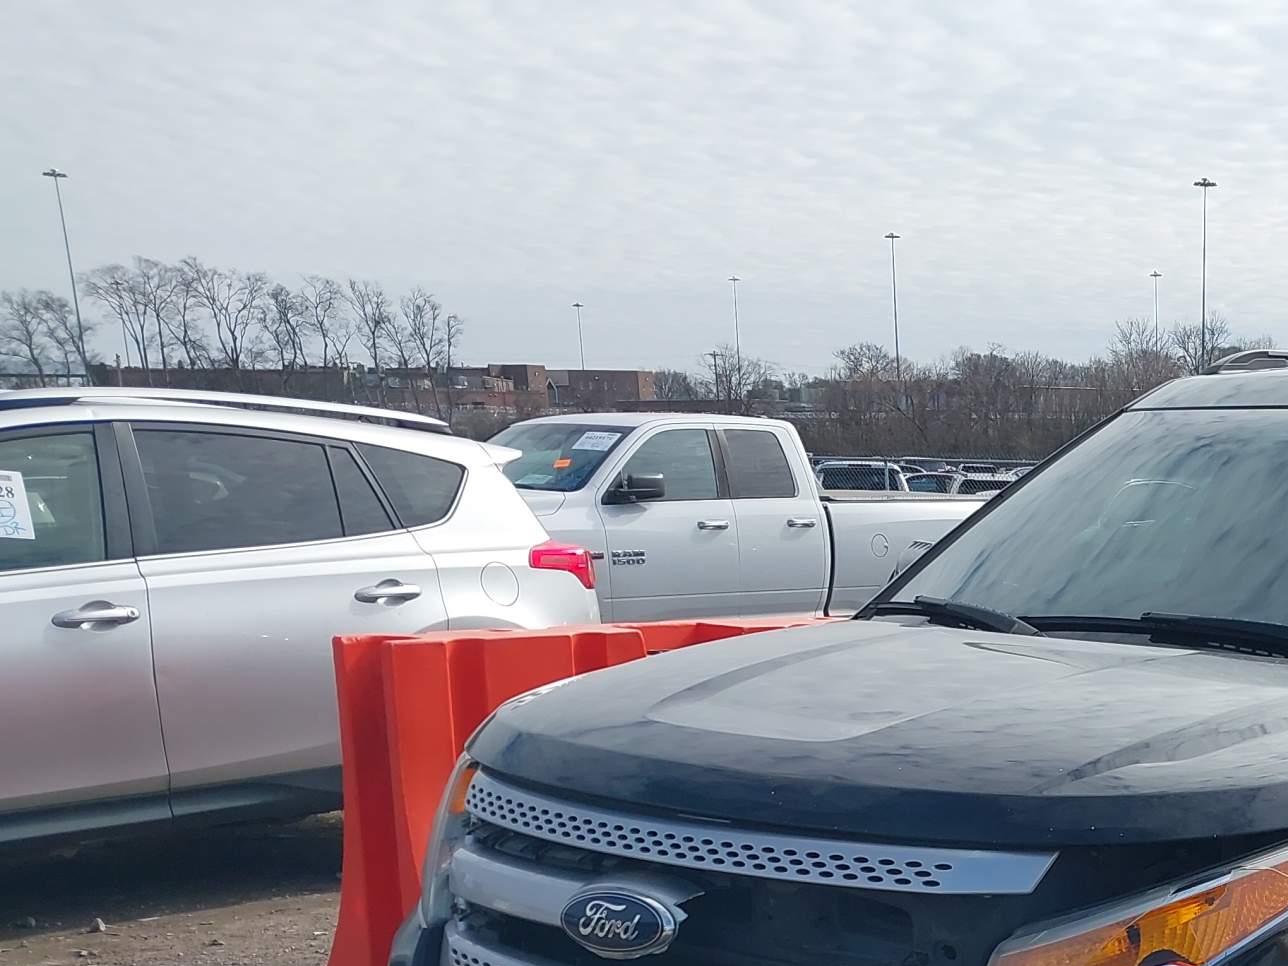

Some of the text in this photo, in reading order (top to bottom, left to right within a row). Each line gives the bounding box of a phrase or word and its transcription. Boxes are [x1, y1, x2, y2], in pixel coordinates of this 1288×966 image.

[611, 550, 646, 558] RAM
[611, 558, 647, 566] 1500
[579, 900, 641, 940] Ford
